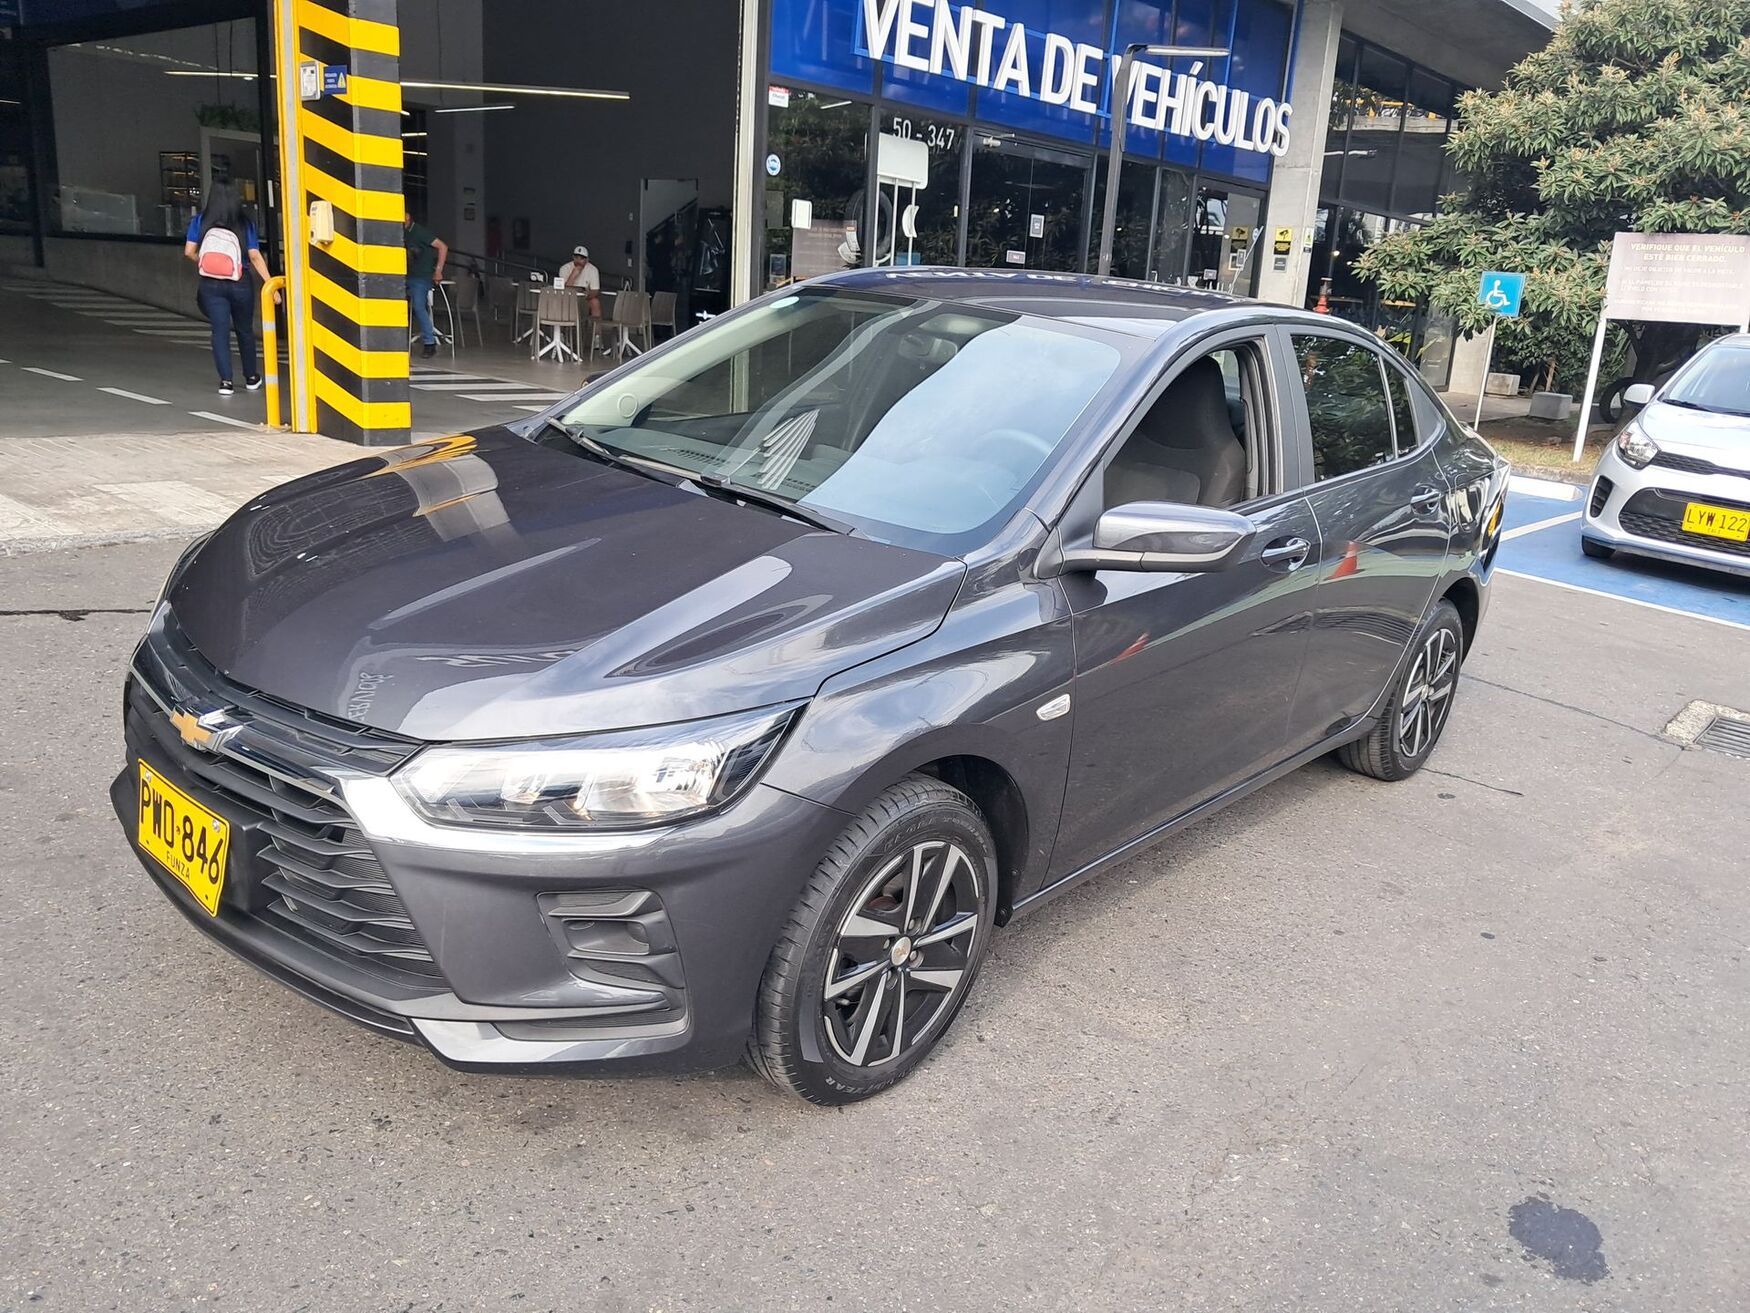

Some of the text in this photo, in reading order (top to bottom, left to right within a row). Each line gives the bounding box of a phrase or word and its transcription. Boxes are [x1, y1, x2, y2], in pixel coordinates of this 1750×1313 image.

[863, 0, 1294, 157] VENTA DE VEHÍCULOS
[893, 117, 912, 141] 50
[927, 124, 955, 150] 347
[1630, 243, 1672, 252] VERIFIQUE
[1674, 244, 1691, 252] QUE
[1687, 509, 1748, 533] LYW 122
[166, 850, 191, 881] FUNZA
